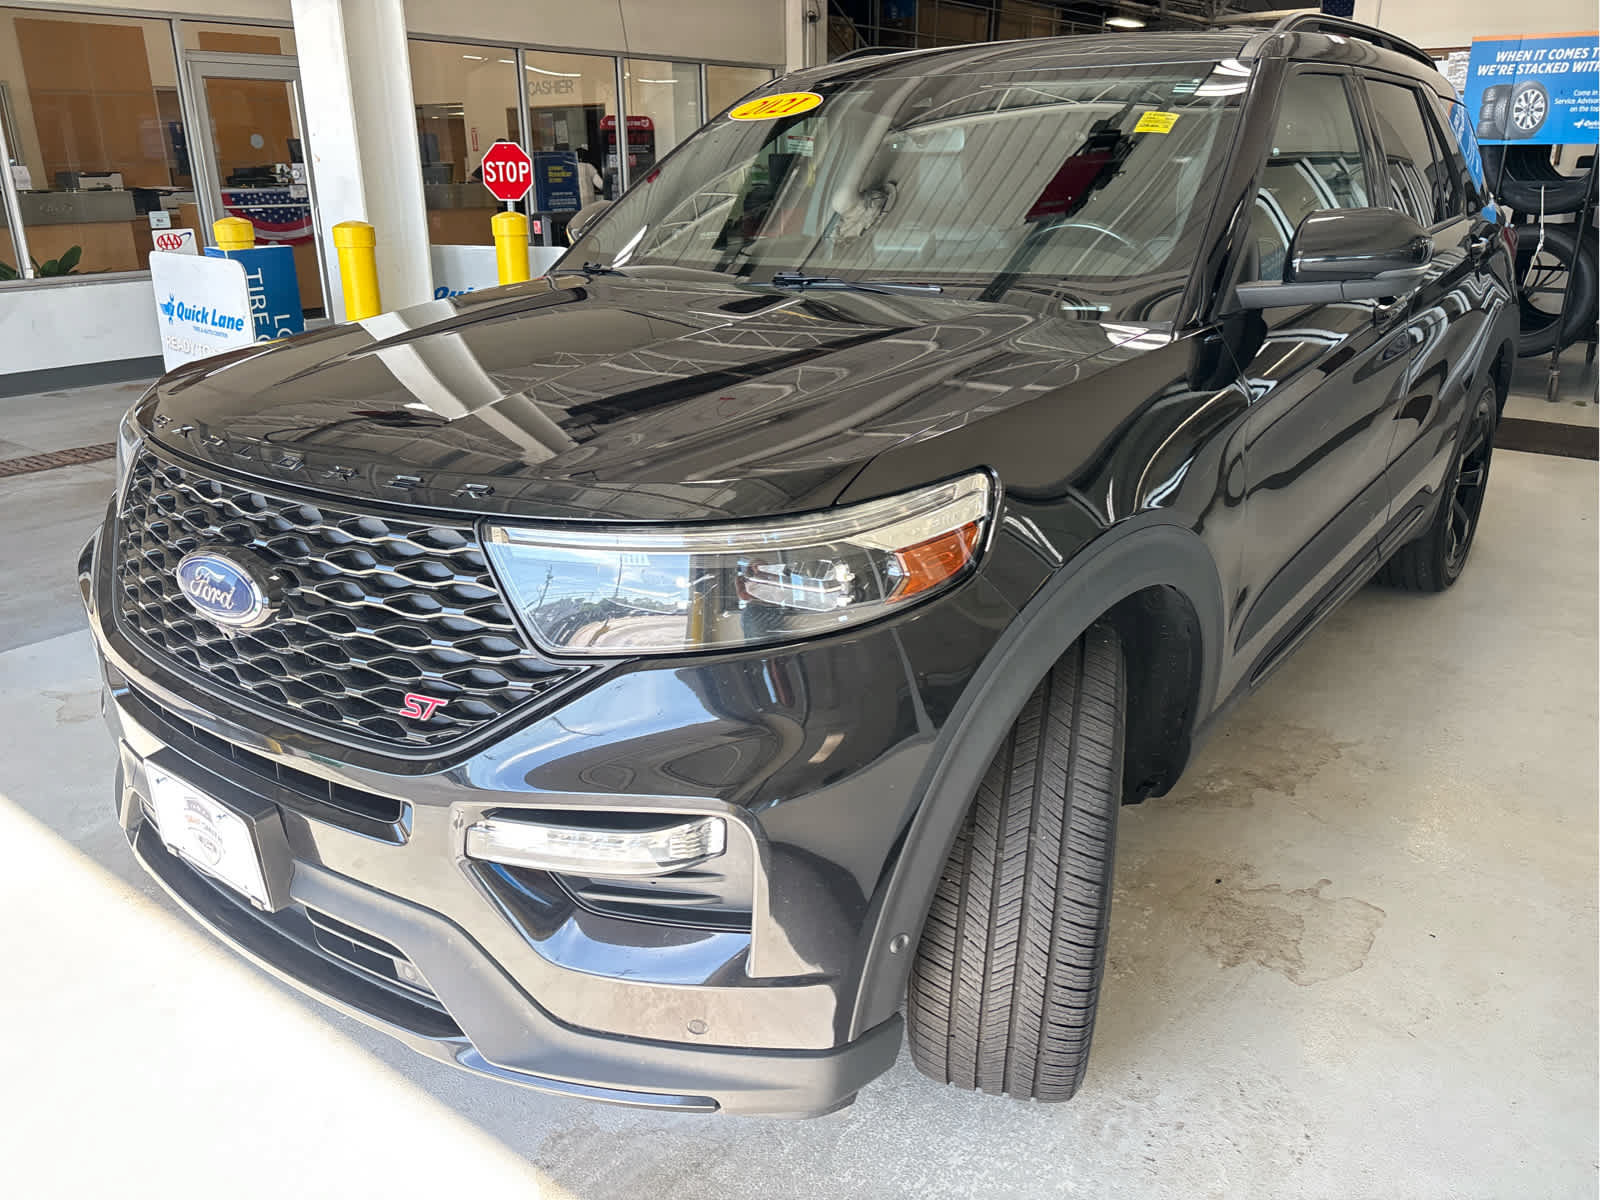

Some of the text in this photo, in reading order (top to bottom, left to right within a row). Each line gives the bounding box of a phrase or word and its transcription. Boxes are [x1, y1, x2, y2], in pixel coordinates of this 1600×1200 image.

[1496, 49, 1533, 62] WHEN
[1534, 48, 1547, 61] IT
[1548, 47, 1590, 60] COMES
[1477, 63, 1515, 76] WE'RE
[1516, 61, 1569, 75] STACKED
[528, 79, 574, 95] CASHIER
[485, 161, 530, 183] STOP
[156, 233, 183, 250] AAA
[247, 267, 270, 325] TIRE
[176, 301, 209, 324] Quick
[211, 308, 245, 332] Lane
[190, 566, 236, 610] Ford
[399, 692, 449, 721] ST
